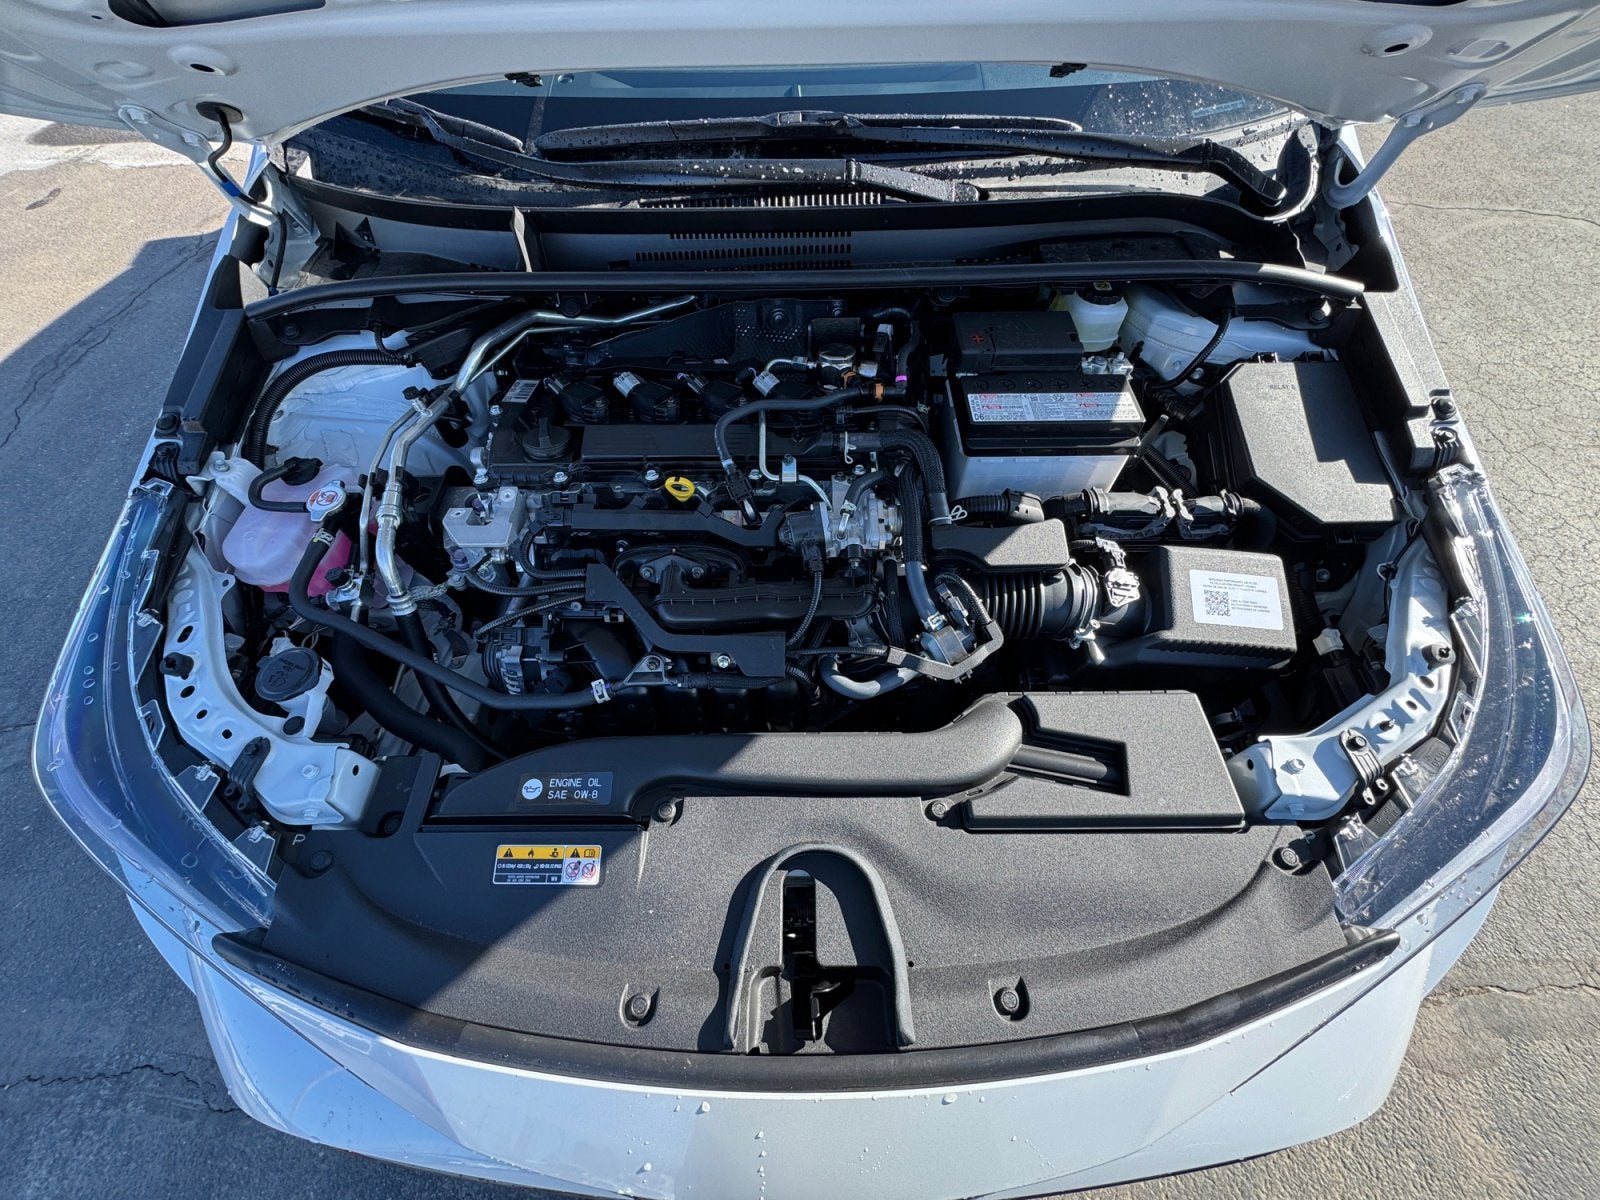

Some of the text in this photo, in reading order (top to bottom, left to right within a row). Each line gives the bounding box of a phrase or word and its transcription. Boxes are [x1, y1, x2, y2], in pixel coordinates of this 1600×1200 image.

[974, 413, 985, 421] D6
[549, 777, 602, 788] ENGINE OIL
[547, 790, 568, 799] SAE
